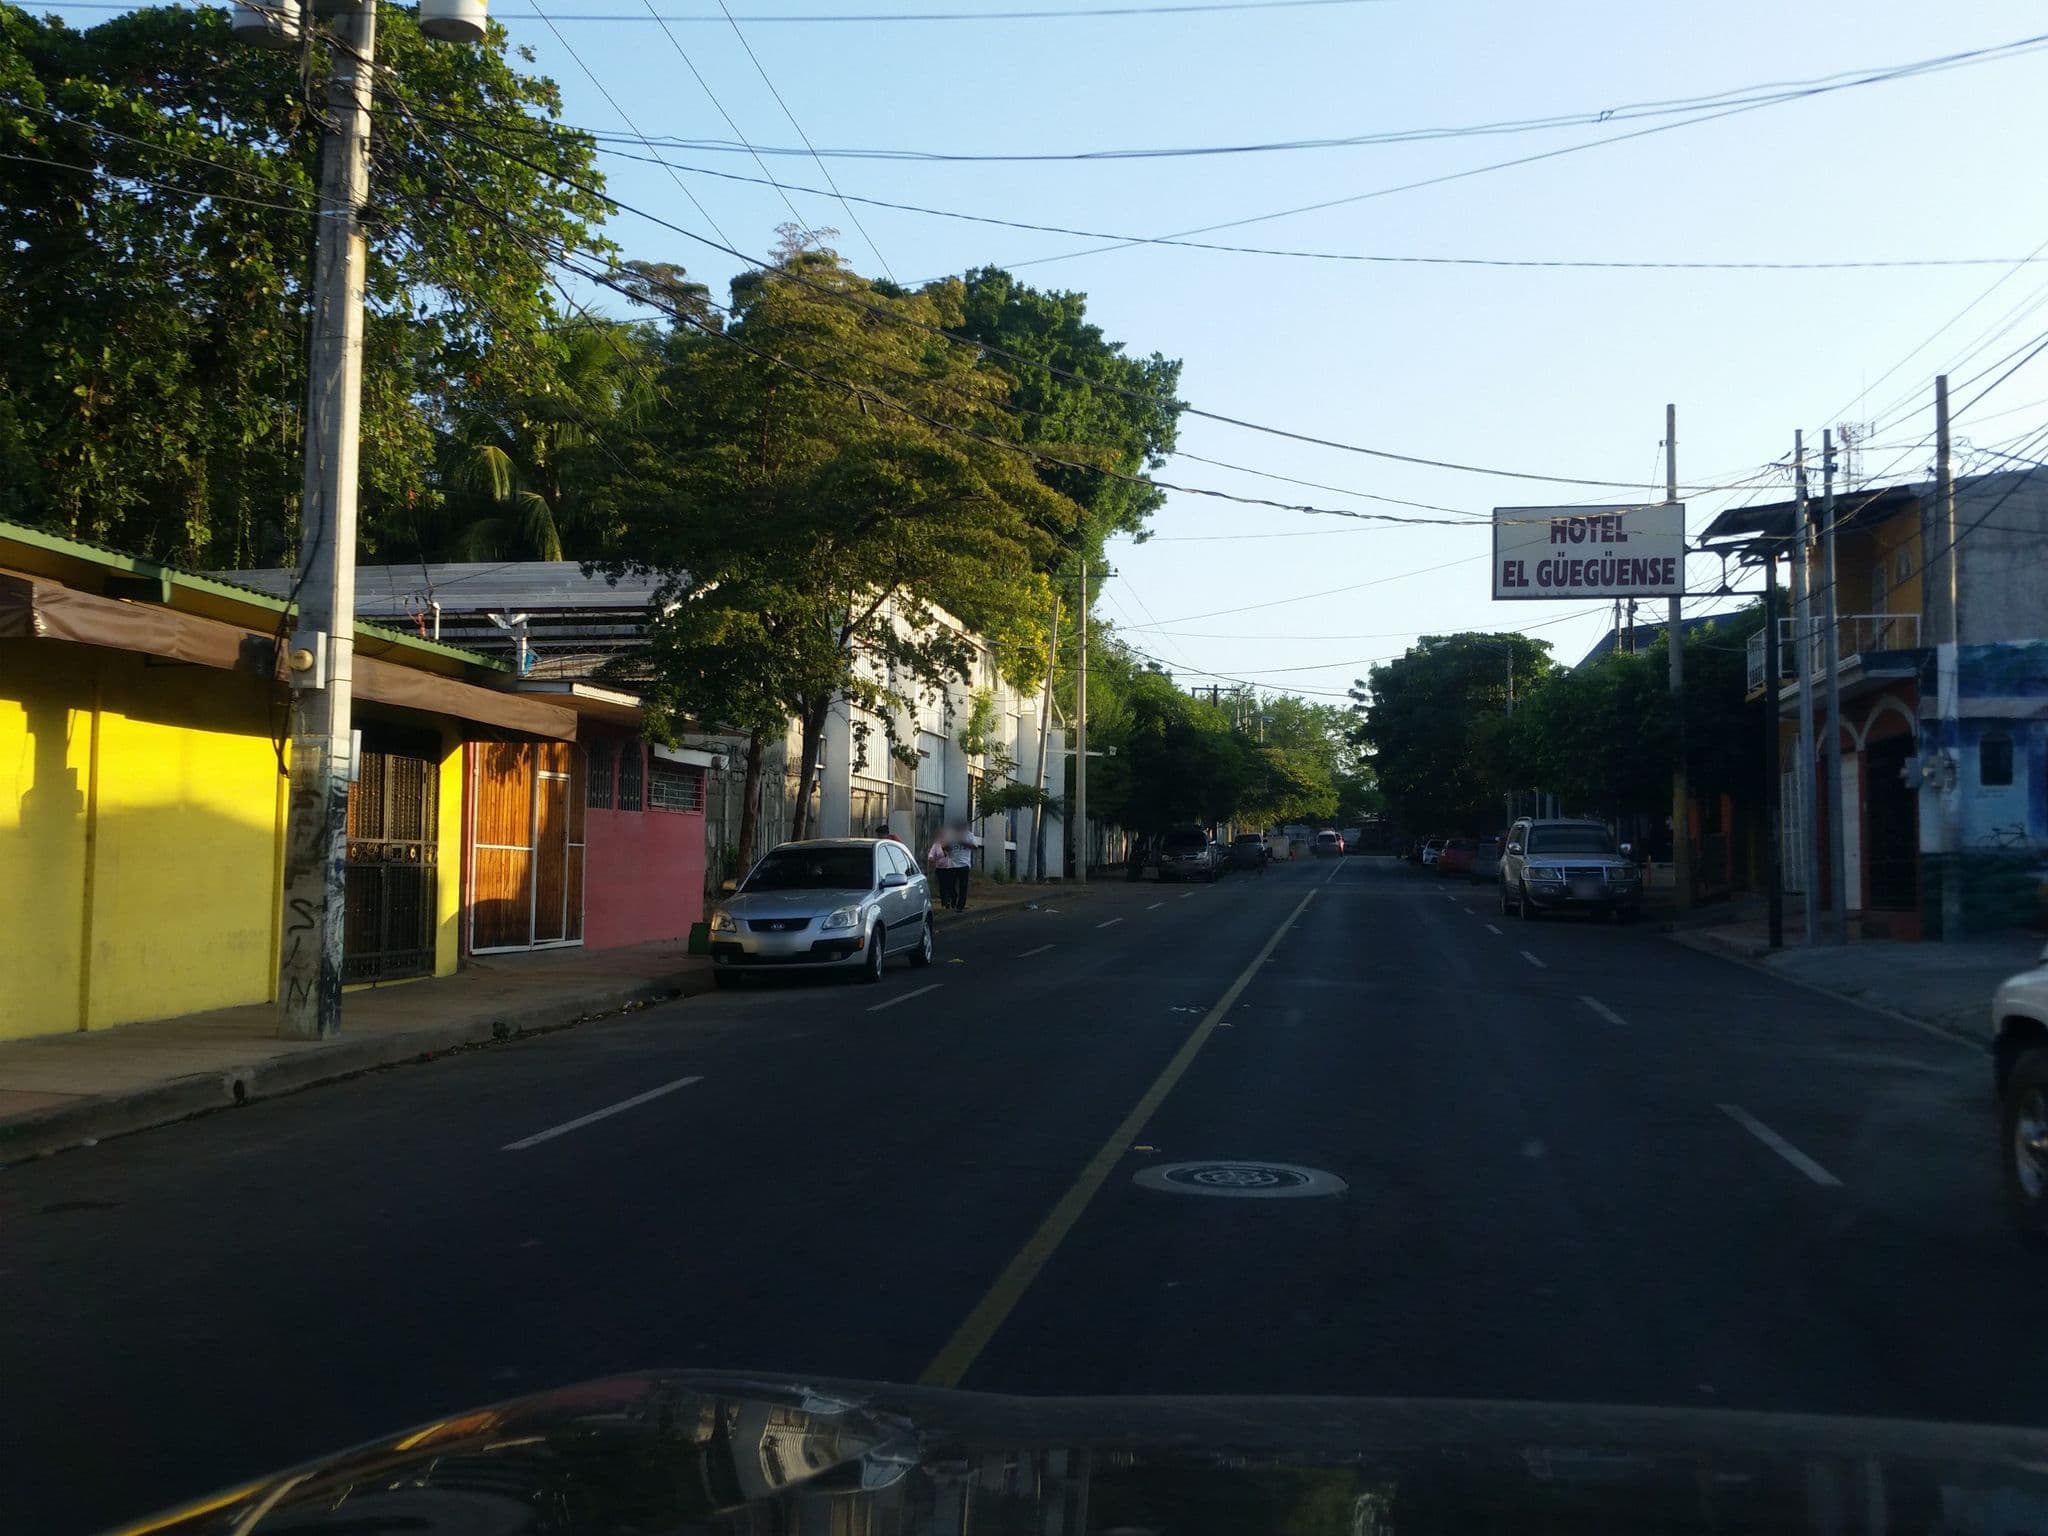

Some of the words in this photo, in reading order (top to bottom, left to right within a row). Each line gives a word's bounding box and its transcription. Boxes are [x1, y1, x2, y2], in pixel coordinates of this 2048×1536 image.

[1551, 515, 1628, 544] HOTEL
[1503, 560, 1529, 587] EL
[1537, 551, 1676, 587] GÜEGÜENSE
